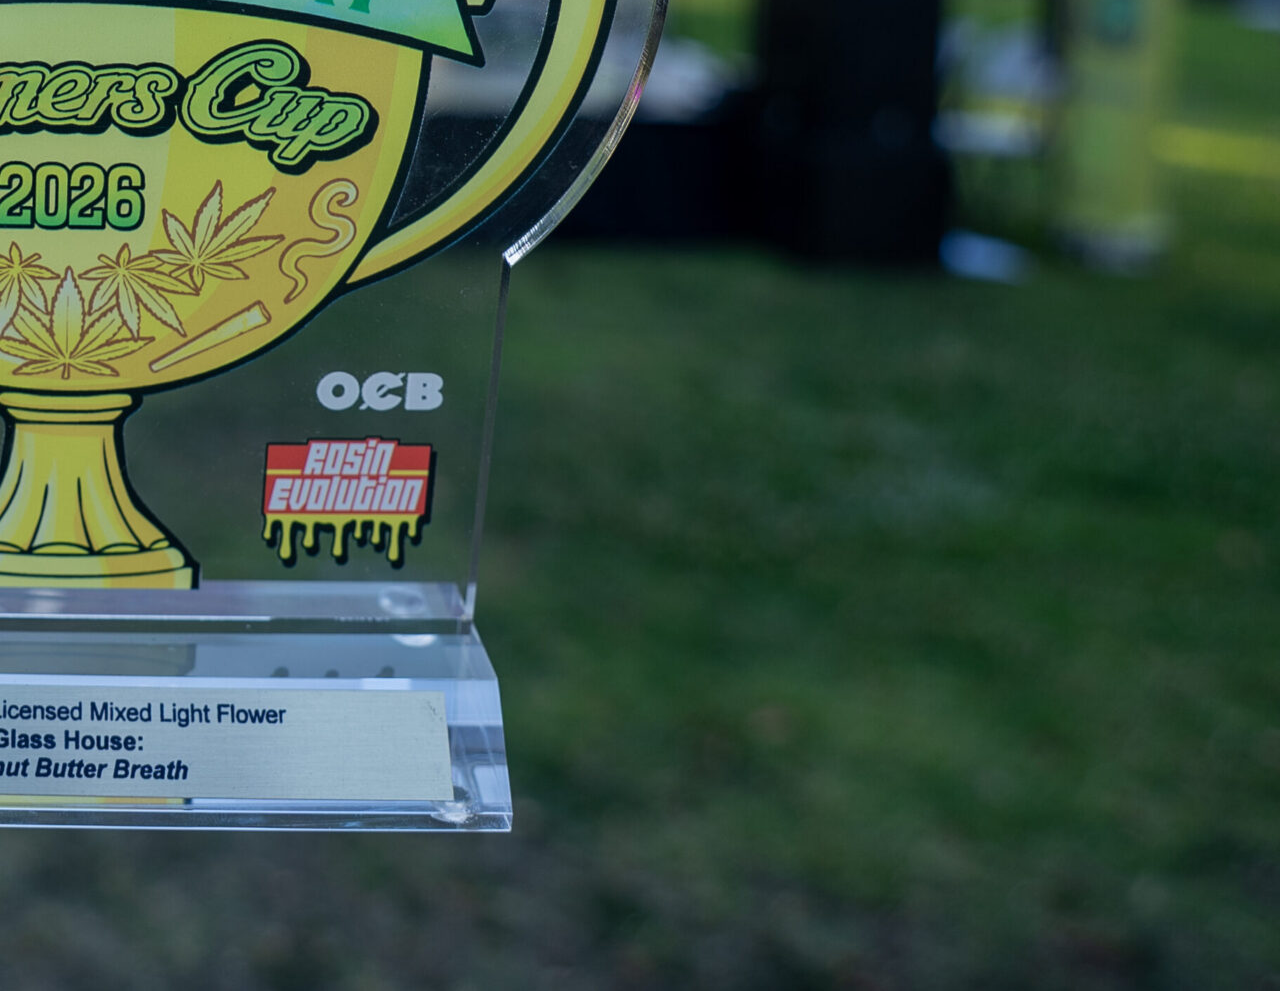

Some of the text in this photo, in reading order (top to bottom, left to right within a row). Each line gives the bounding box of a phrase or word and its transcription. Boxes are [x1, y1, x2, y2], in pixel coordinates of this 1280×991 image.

[180, 40, 376, 170] Cup
[317, 371, 444, 411] OCB
[90, 702, 152, 722] Mixed
[160, 703, 210, 728] Light
[217, 704, 287, 724] Flower
[64, 730, 143, 750] House:
[35, 757, 107, 779] Butter
[113, 759, 189, 780] Breath
